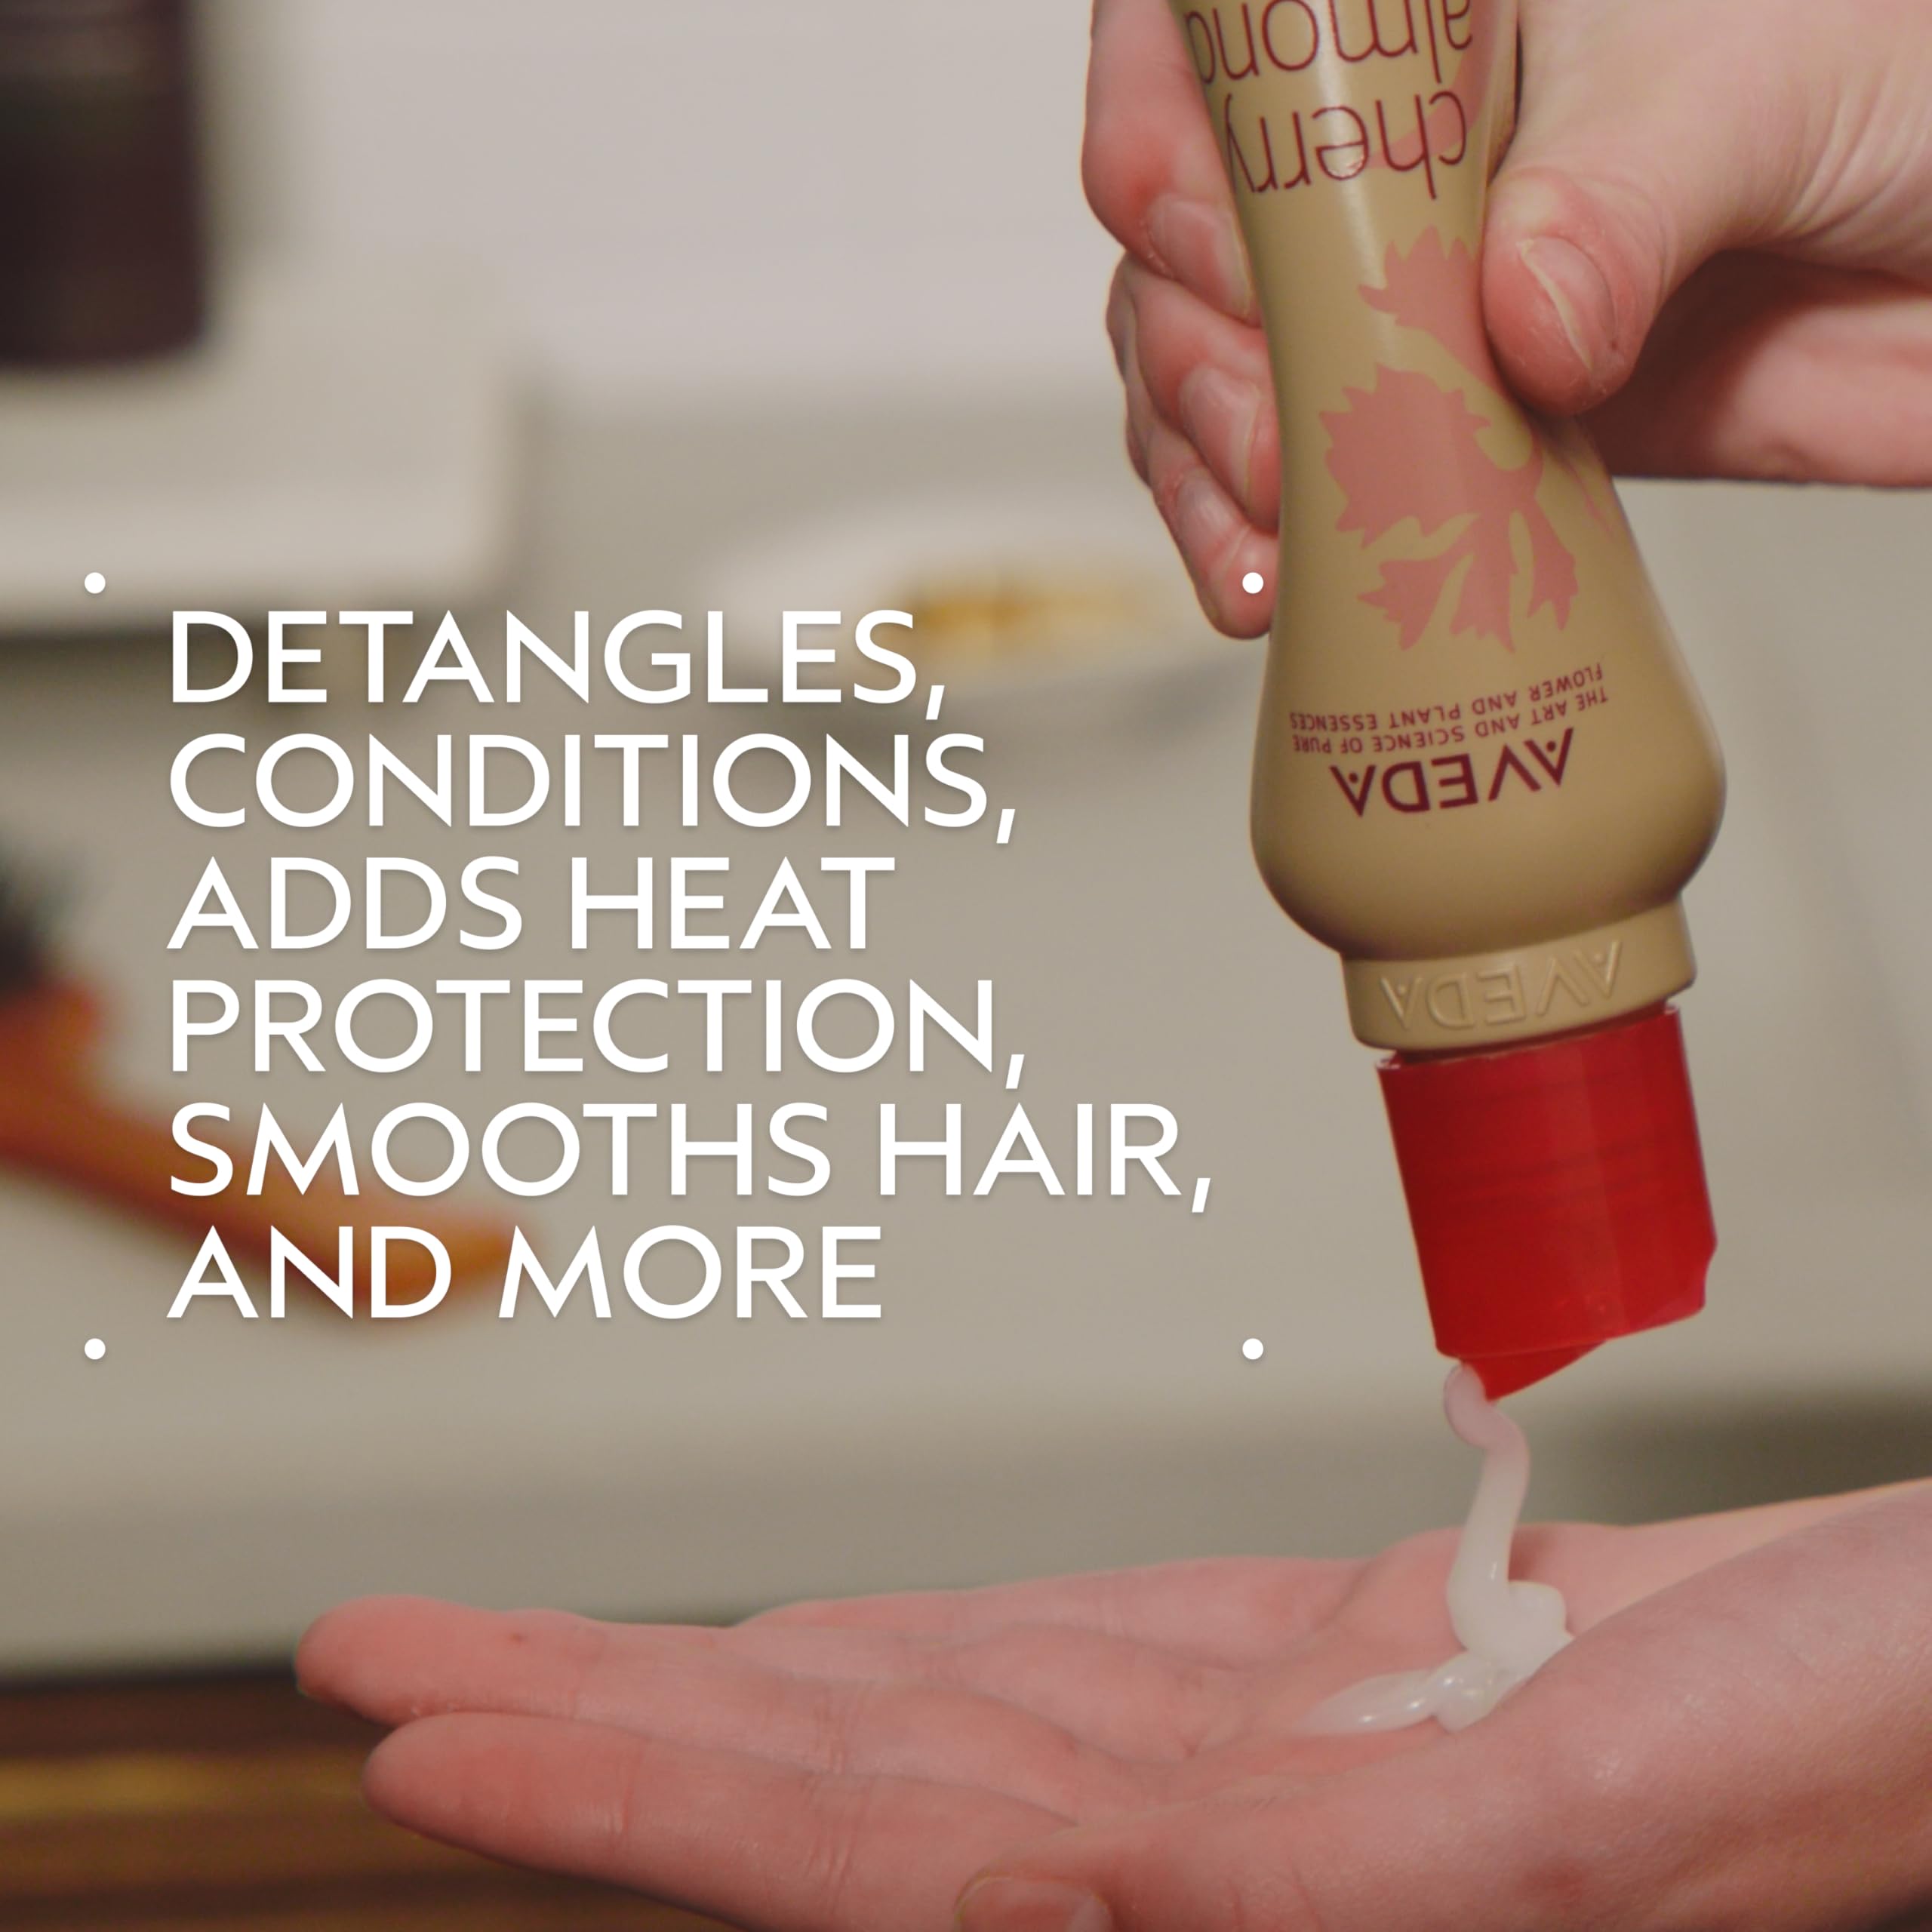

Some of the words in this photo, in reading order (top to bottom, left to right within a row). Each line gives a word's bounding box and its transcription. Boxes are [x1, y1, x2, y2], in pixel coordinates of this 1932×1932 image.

[1225, 91, 1466, 199] cherry
[1528, 663, 1604, 702] FLOWER
[1472, 690, 1518, 716] AND
[1577, 686, 1609, 712] THE
[1289, 712, 1377, 731] ESSENCES
[1389, 703, 1461, 729] PLANT
[1475, 713, 1520, 739] AND
[1531, 700, 1567, 726] ART
[1292, 734, 1332, 754] PURE
[1340, 736, 1363, 754] OF
[1373, 725, 1465, 753] SCIENCE
[1329, 727, 1574, 817] AVEDA
[1380, 939, 1622, 1031] AVEDA
